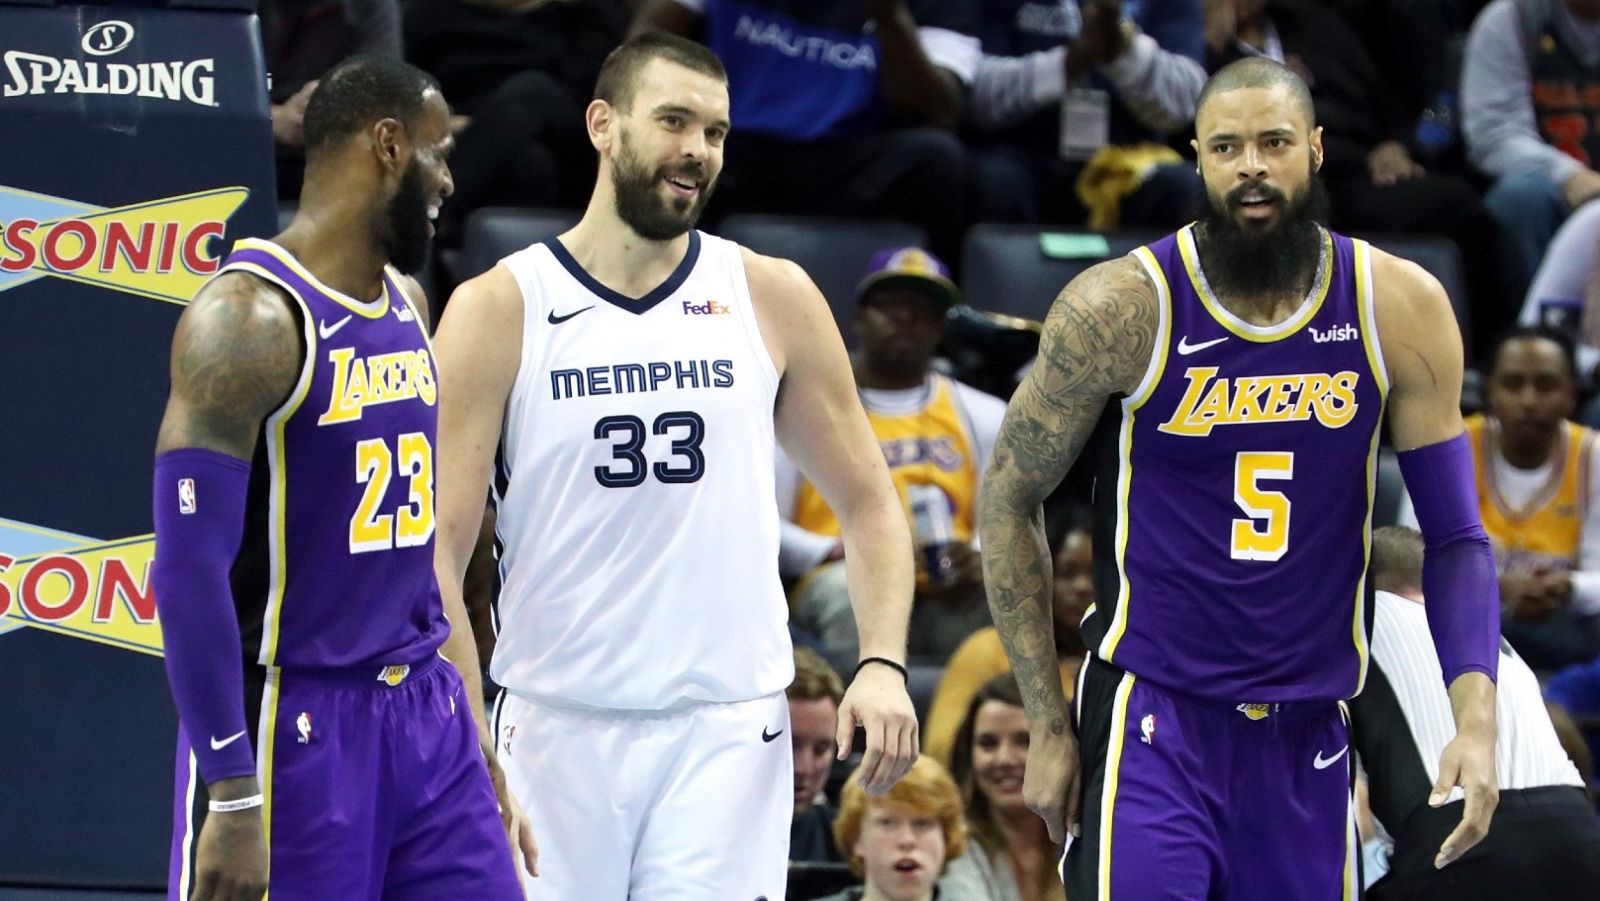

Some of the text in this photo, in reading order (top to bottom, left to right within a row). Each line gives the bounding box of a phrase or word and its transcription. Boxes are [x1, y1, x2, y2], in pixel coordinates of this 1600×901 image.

[734, 15, 877, 71] NAUTICA
[3, 50, 215, 107] SPALDING
[0, 218, 227, 273] SONIC
[682, 300, 731, 315] FedEx
[1308, 323, 1359, 343] wish
[317, 347, 437, 426] LAKERS
[550, 360, 735, 400] MEMPHIS
[1157, 366, 1360, 437] LAKERS
[594, 410, 706, 488] 33
[350, 432, 436, 554] 23
[1230, 451, 1294, 562] 5
